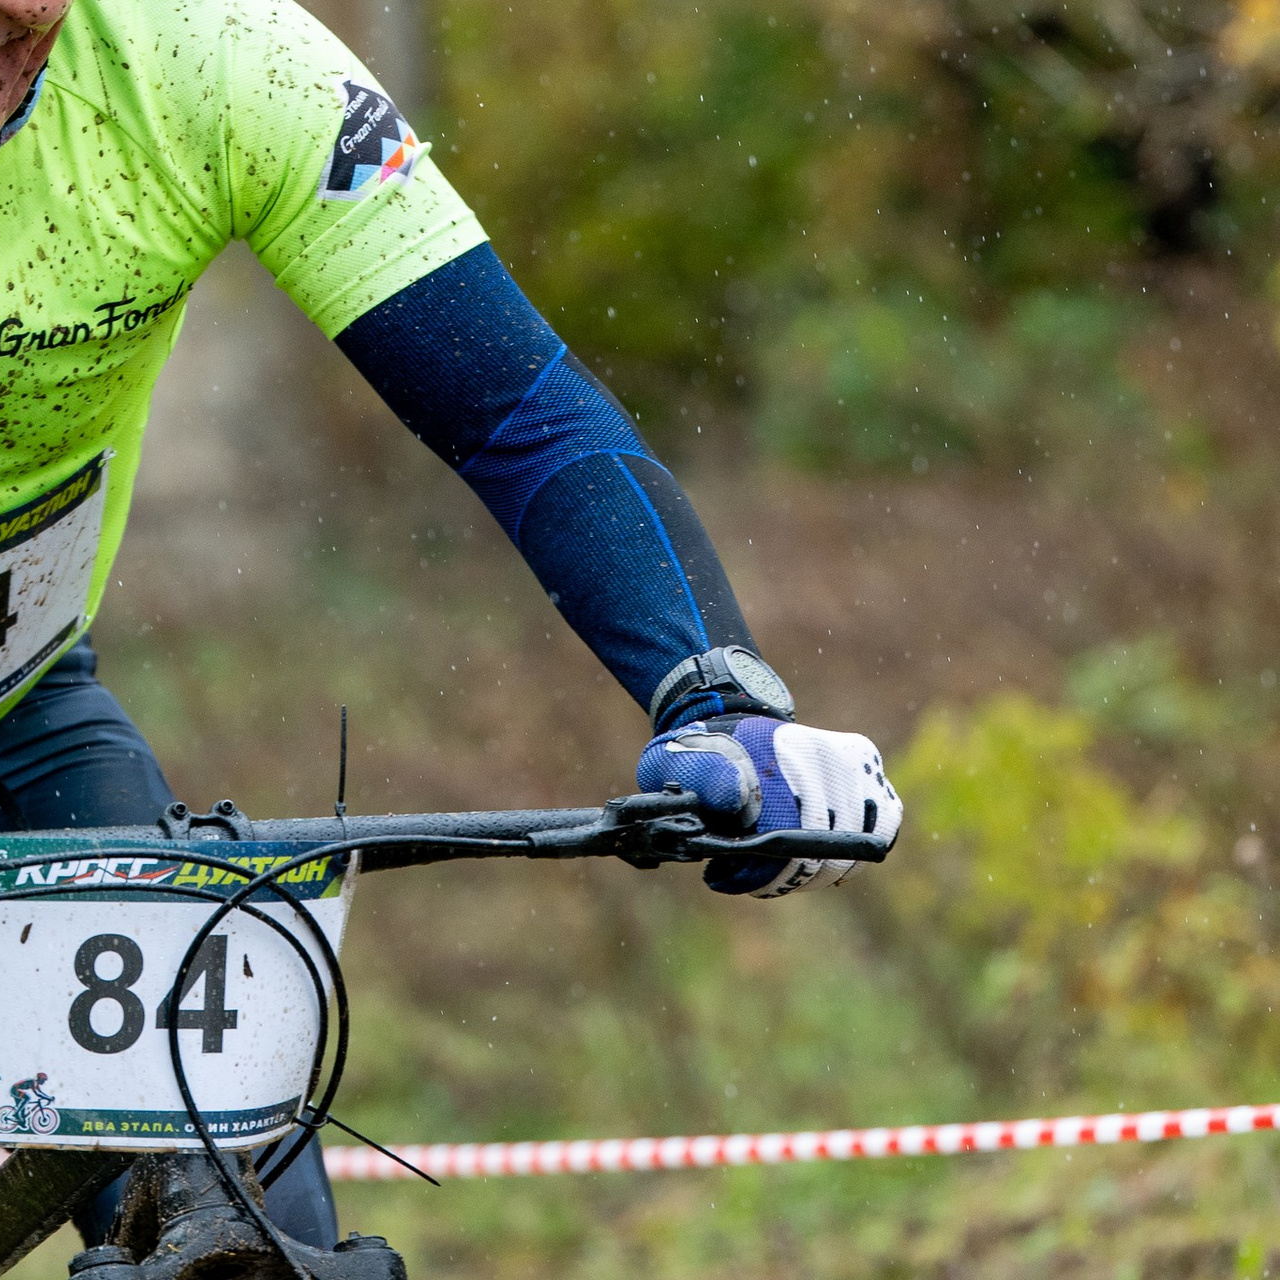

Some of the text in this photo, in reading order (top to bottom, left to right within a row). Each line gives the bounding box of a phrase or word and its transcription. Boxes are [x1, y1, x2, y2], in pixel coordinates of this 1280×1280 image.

[68, 934, 238, 1054] 84
[82, 1121, 116, 1132] ДВА
[121, 1122, 180, 1132] ЭТАПА.
[184, 1122, 228, 1135] ОИН
